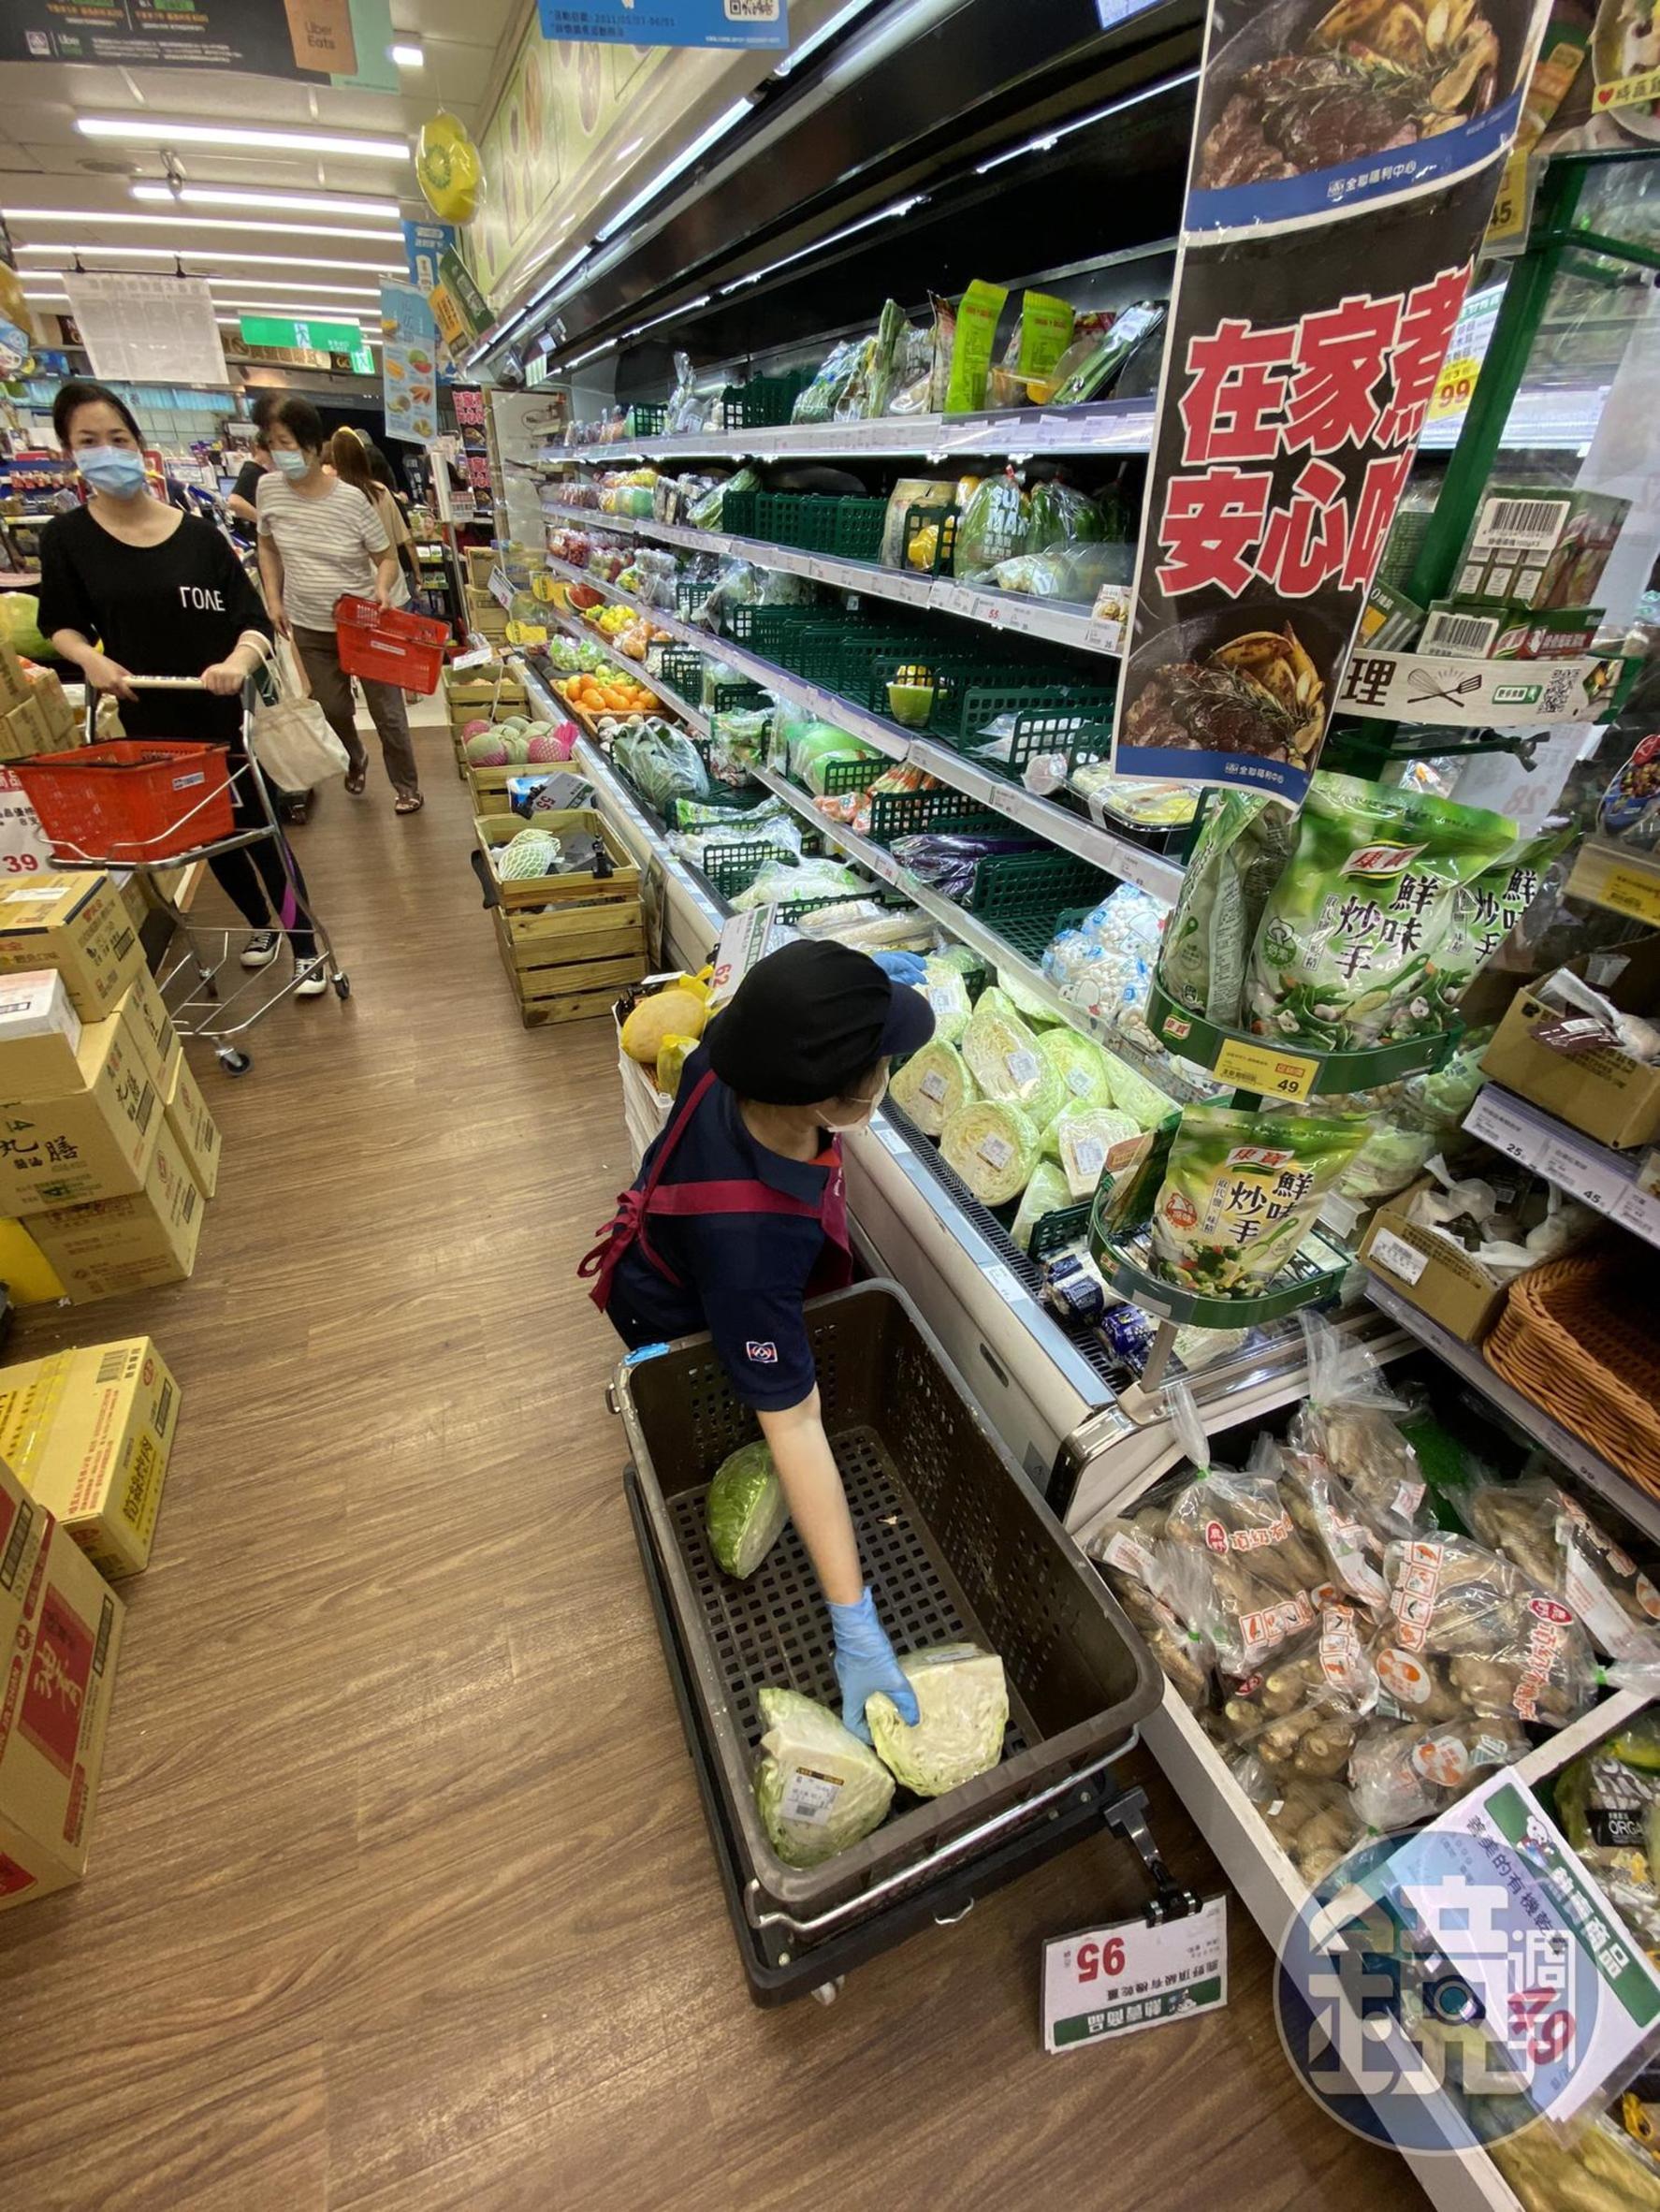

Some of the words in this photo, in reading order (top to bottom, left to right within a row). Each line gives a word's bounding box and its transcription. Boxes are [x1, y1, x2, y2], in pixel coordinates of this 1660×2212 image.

[304, 21, 332, 36] Uber
[307, 35, 336, 50] Eats
[1438, 378, 1471, 407] 99
[1341, 658, 1397, 706] 理
[2, 853, 38, 873] 39
[1276, 1079, 1300, 1094] 49
[1506, 1142, 1523, 1157] 25
[1582, 1190, 1602, 1204] 45
[1225, 1181, 1268, 1244] 炒手
[1077, 1937, 1126, 1984] 95
